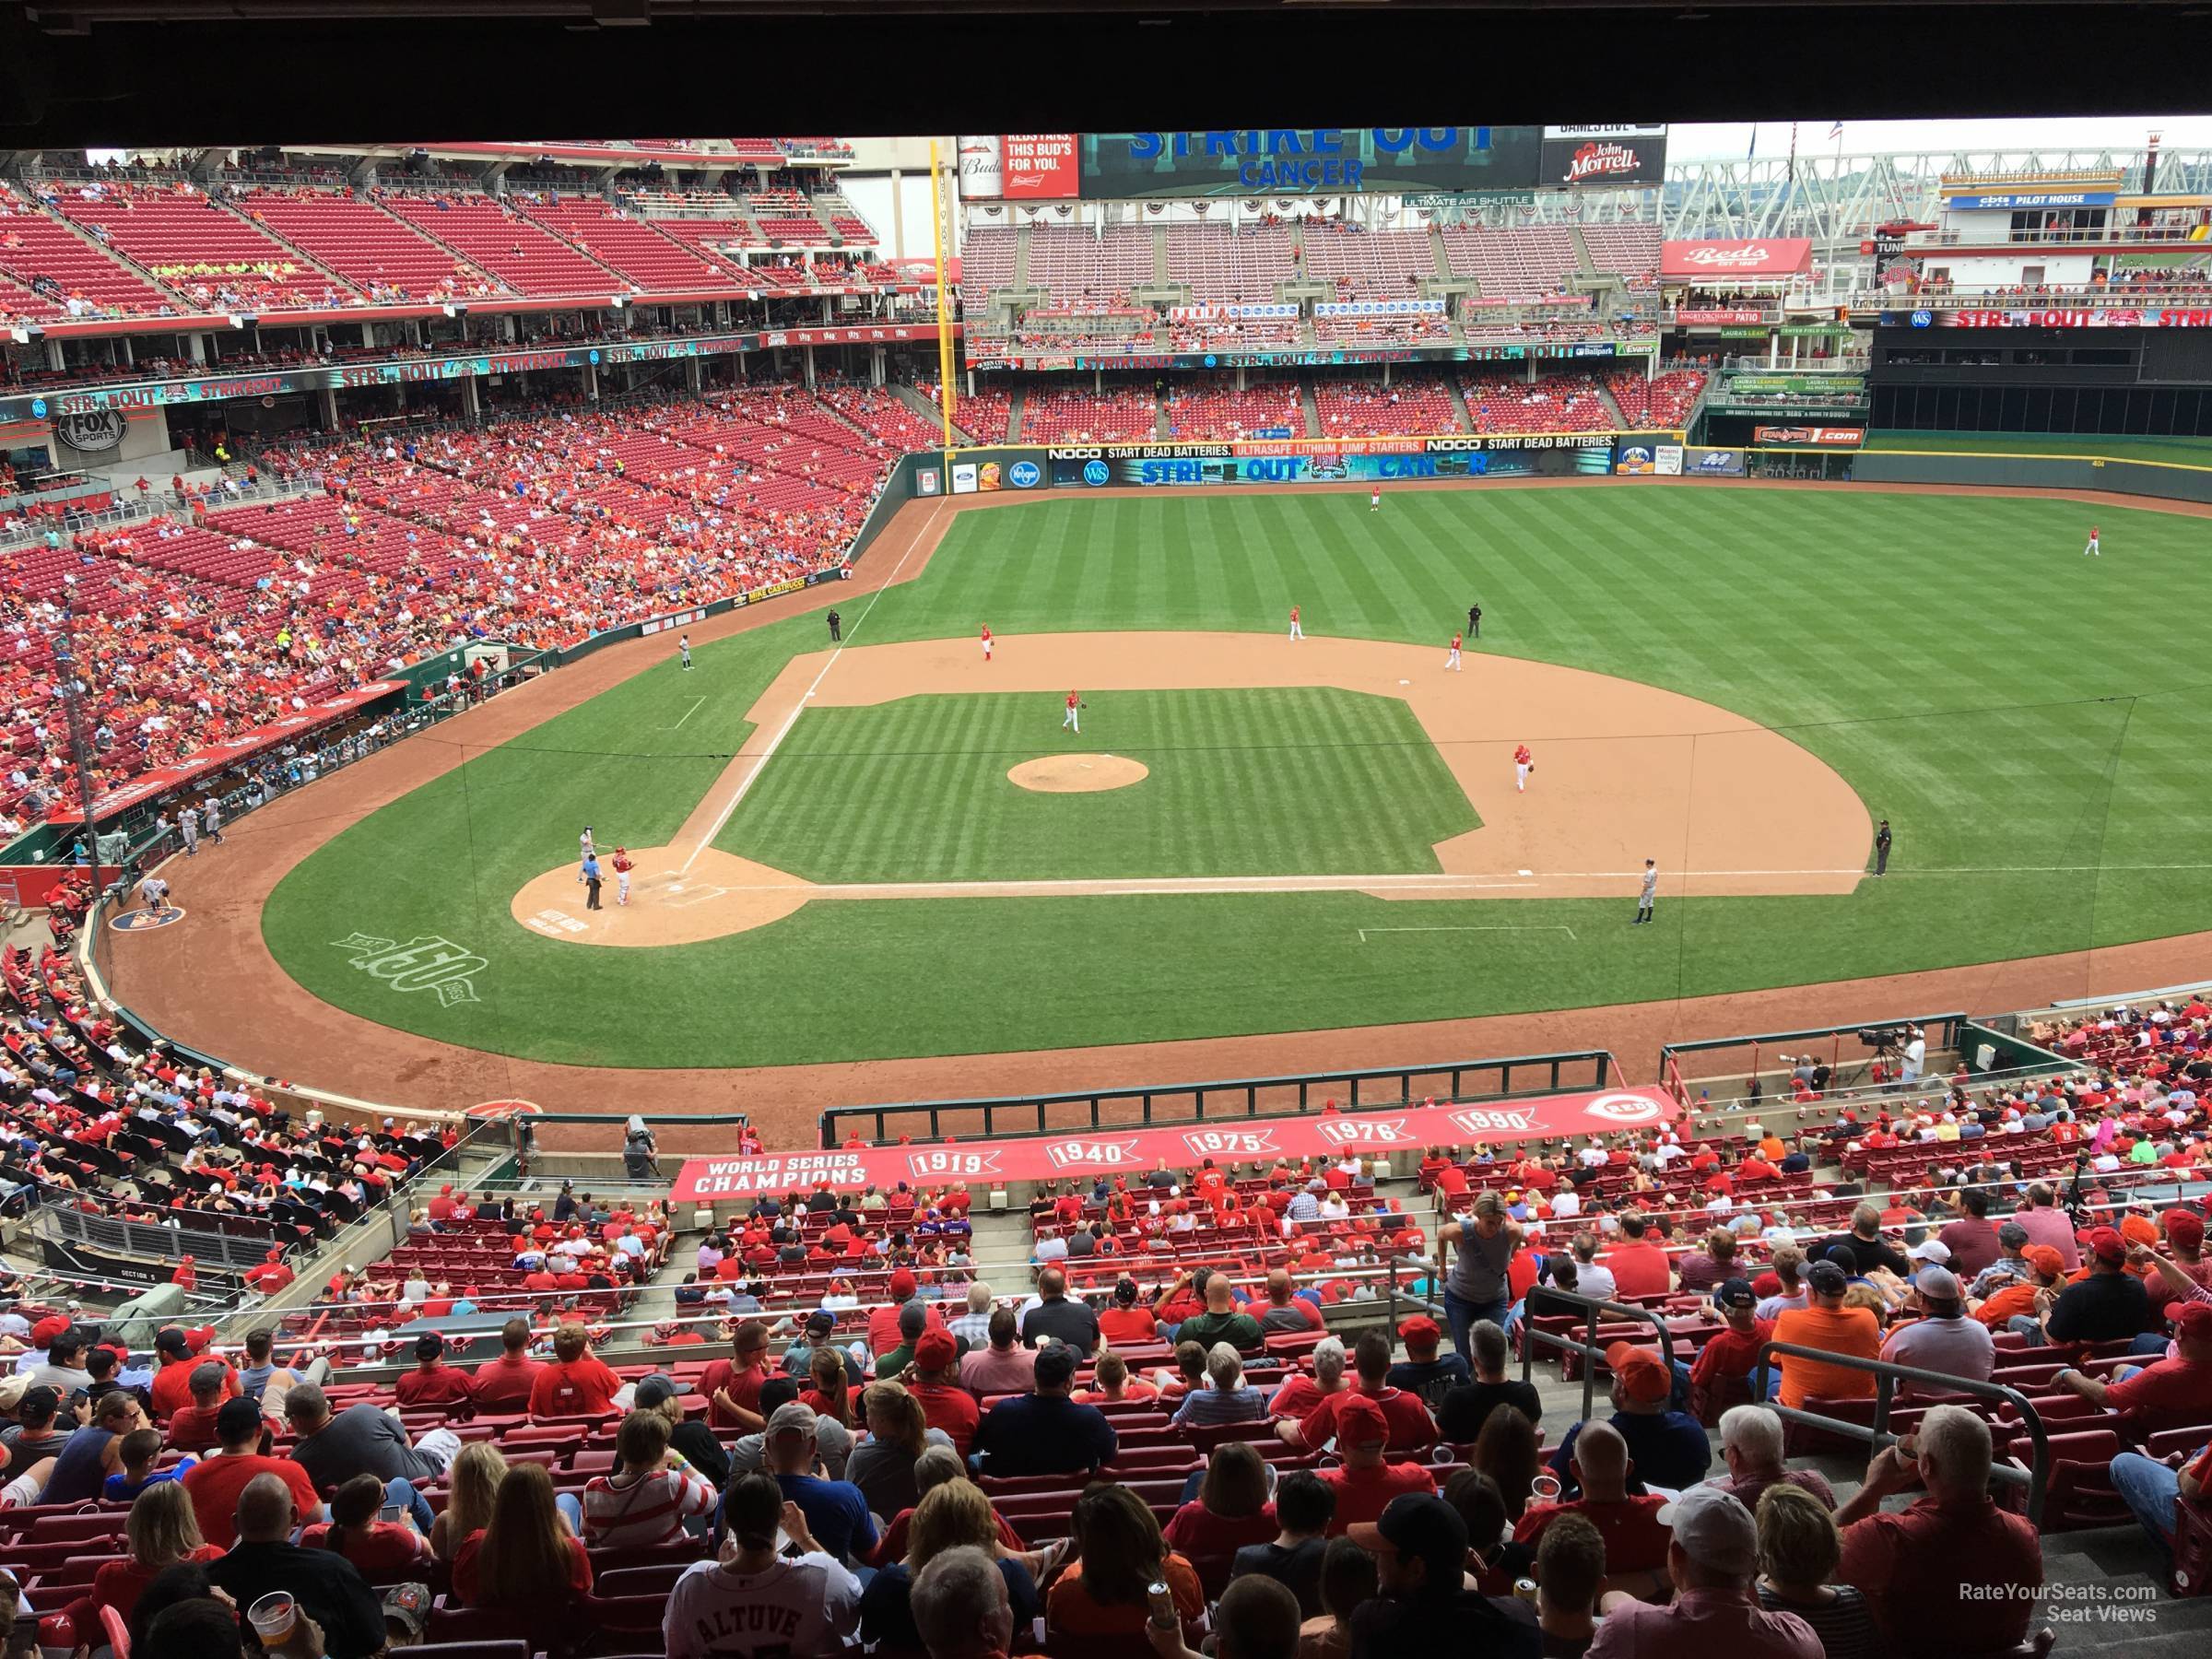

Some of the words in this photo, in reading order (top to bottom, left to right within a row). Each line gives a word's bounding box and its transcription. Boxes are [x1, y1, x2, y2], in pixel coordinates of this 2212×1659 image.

[1008, 144, 1034, 156] THIS
[1037, 143, 1071, 156] BUD'S
[1593, 142, 1622, 157] John
[1008, 159, 1030, 171] FOR
[1032, 159, 1060, 171] YOU.
[1239, 159, 1365, 187] CANCER
[1563, 149, 1641, 182] Morrell
[1405, 197, 1457, 207] ULTIMATE
[1459, 196, 1476, 206] AIR
[1479, 195, 1529, 206] SHUTTLE
[2016, 195, 2045, 205] PILOT
[2049, 194, 2084, 204] HOUSE
[1683, 244, 1770, 264] Reds
[1735, 313, 1758, 322] PATIO
[1584, 347, 1613, 356] Ballpark
[75, 411, 113, 433] FOX
[76, 431, 116, 443] SPORTS
[1427, 439, 1481, 451] NOCO
[1488, 438, 1522, 449] START
[1524, 437, 1554, 448] DEAD
[1556, 435, 1615, 447] BATTERIES.
[1049, 449, 1101, 460] NOCO
[1108, 447, 1141, 458] START
[1143, 447, 1172, 458] DEAD
[1174, 445, 1231, 457] BATTERIES.
[1237, 442, 1292, 455] ULTRASAFE
[1296, 441, 1336, 454] LITHIUM
[1339, 441, 1367, 453] JUMP
[1369, 441, 1421, 453] STARTERS.
[1014, 466, 1037, 483] Kroger
[1247, 458, 1301, 481] OUT
[1378, 453, 1488, 477] CANR
[748, 588, 767, 600] MIKE
[768, 579, 805, 594] CASTRUCCI
[1329, 1119, 1397, 1142] 1976
[1461, 1112, 1527, 1132] 1990
[1195, 1129, 1261, 1154] 1975
[914, 1149, 982, 1174] 1919
[1054, 1141, 1123, 1163] 1940
[708, 1158, 777, 1175] WORLD
[786, 1154, 859, 1171] SERIES
[694, 1166, 867, 1194] CHAMPIONS
[122, 1270, 147, 1279] SECTION
[696, 1605, 803, 1644] ALTUVE
